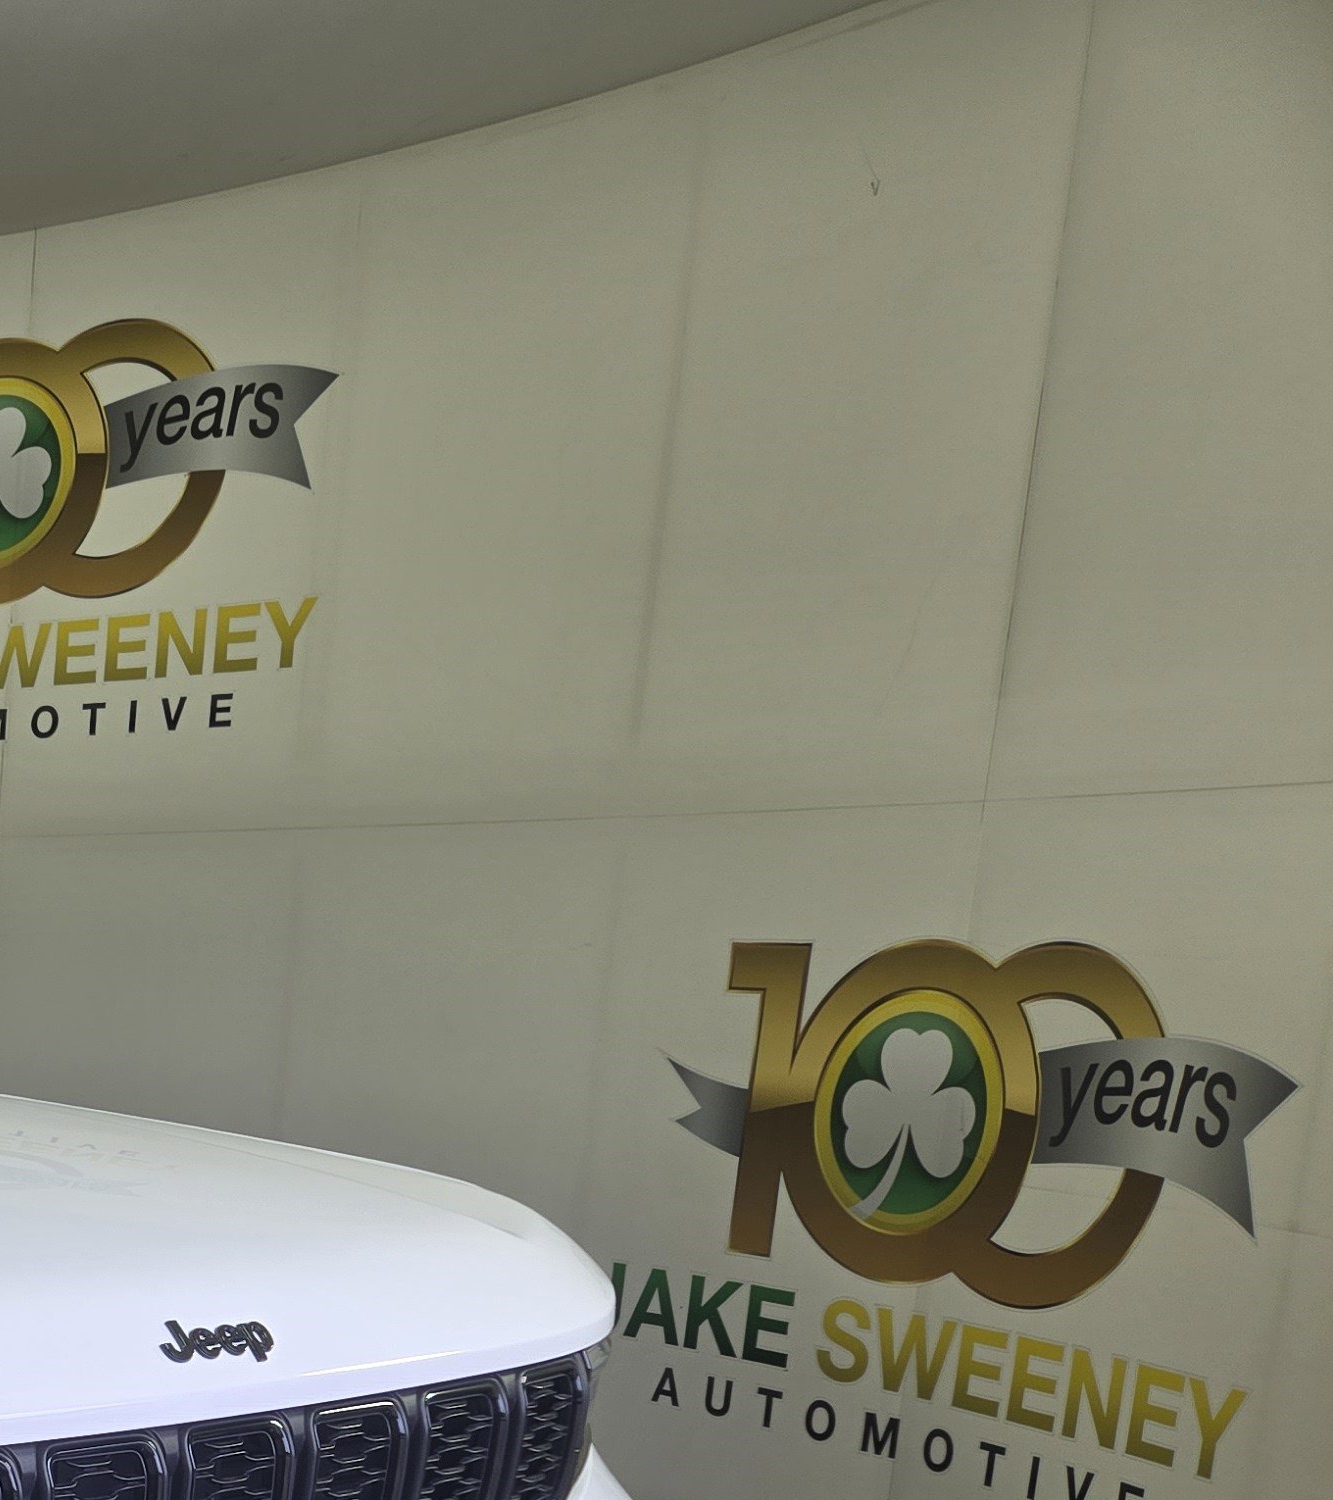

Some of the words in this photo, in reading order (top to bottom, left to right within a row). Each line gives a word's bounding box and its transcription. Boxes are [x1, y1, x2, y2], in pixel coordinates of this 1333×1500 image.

[120, 379, 284, 473] years
[726, 939, 1167, 1310] 100
[1048, 1055, 1237, 1148] years
[159, 1319, 275, 1364] Jeep
[815, 1299, 1251, 1482] SWEENEY
